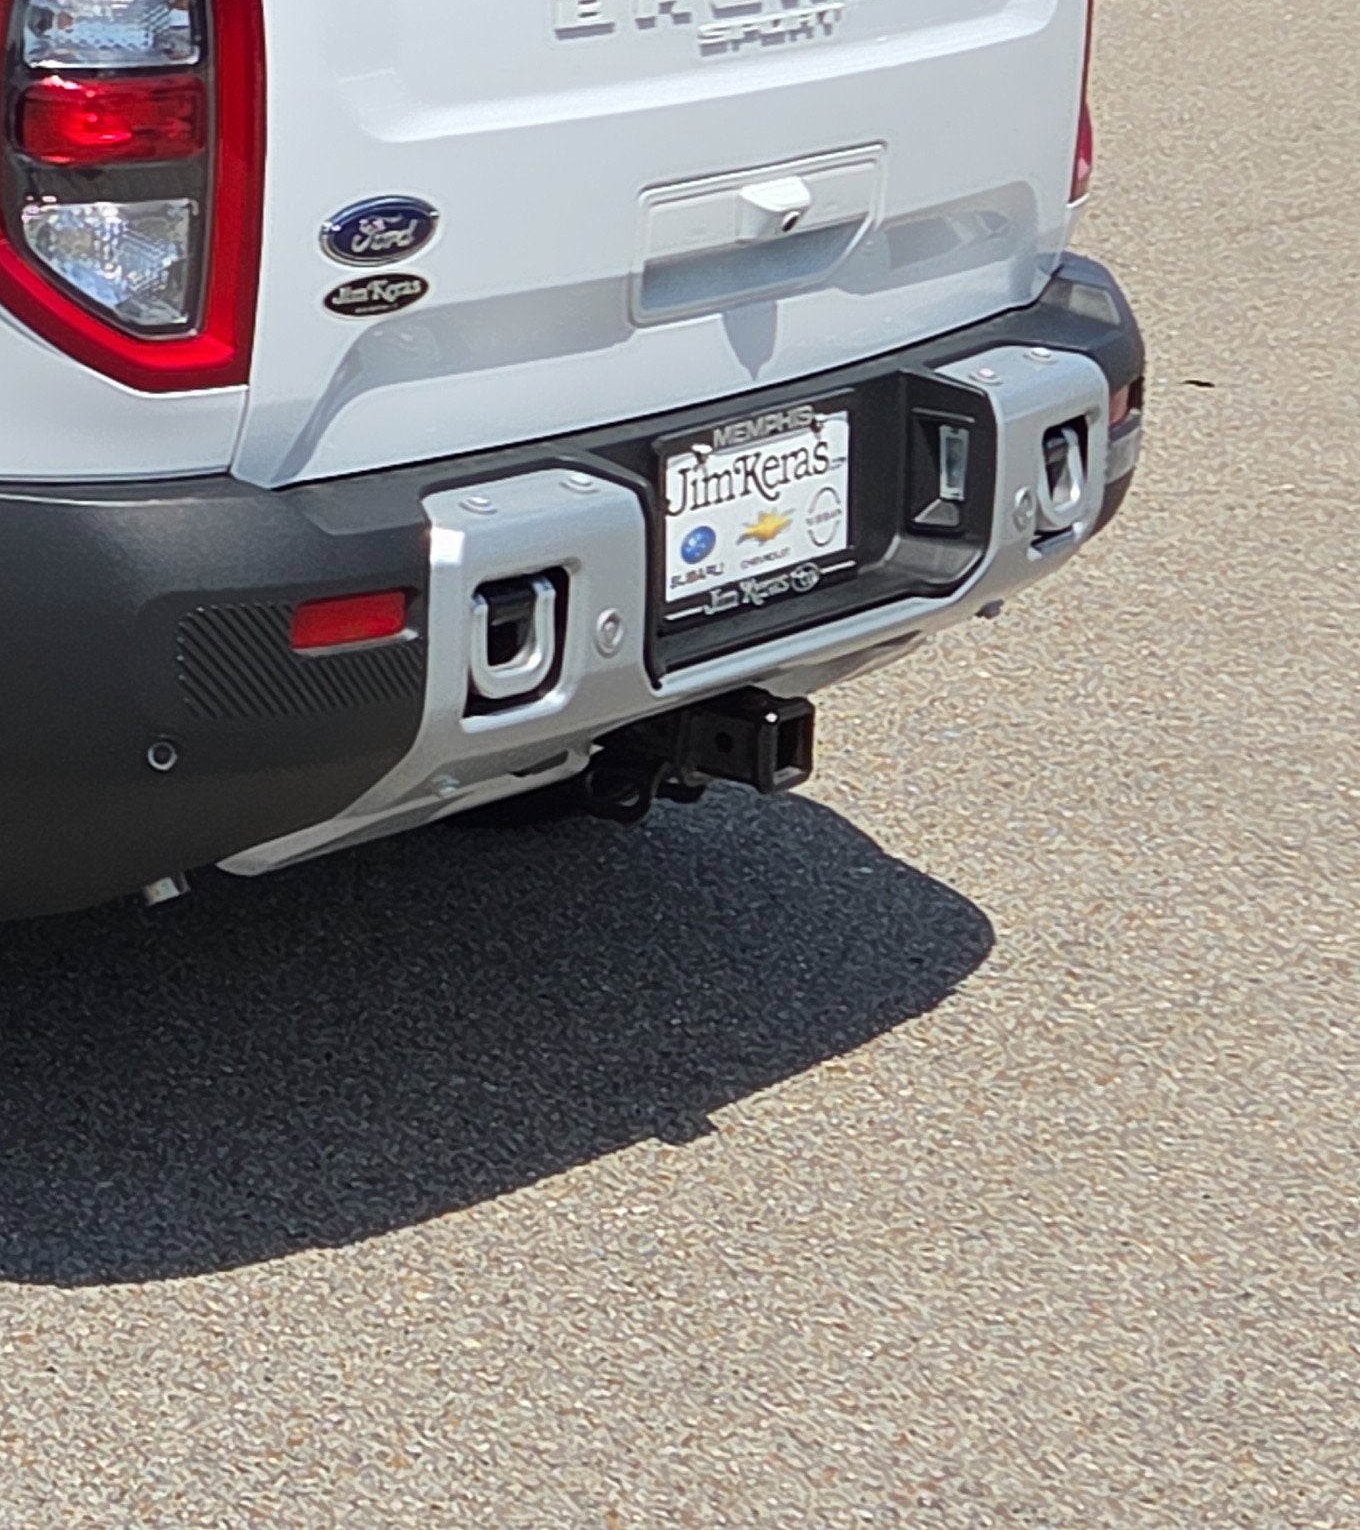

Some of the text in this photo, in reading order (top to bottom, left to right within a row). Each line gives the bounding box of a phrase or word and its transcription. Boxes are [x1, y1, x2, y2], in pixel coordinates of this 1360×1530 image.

[698, 2, 846, 53] SPORT
[350, 213, 419, 254] Ford
[712, 404, 815, 449] MEMPHIS
